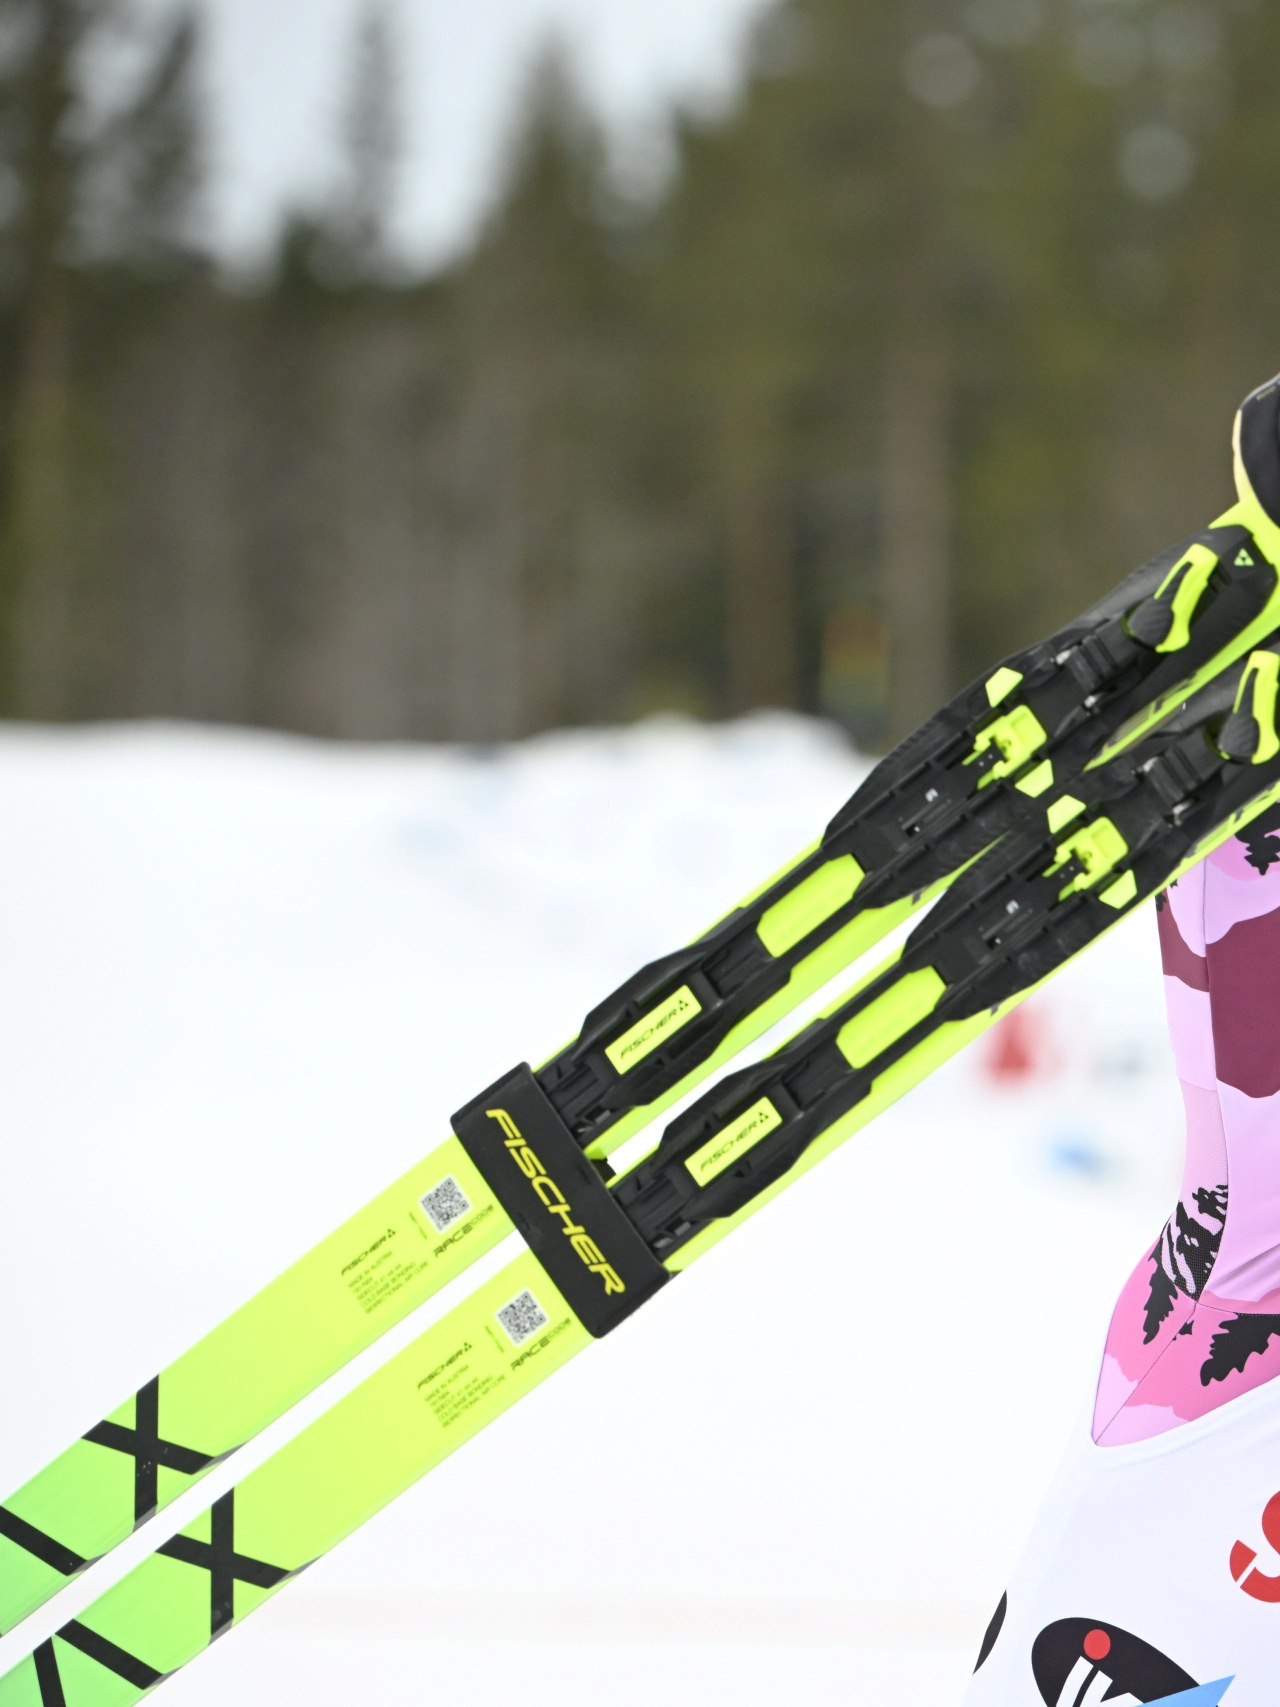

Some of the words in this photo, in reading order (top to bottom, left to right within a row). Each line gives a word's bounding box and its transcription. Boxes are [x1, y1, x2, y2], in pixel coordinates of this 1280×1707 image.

[620, 1008, 677, 1060] FISCHER
[700, 1121, 757, 1171] FISCHER
[486, 1109, 625, 1296] FISCHER
[342, 1236, 386, 1276] FISCHER
[417, 1349, 463, 1390] FISCHER
